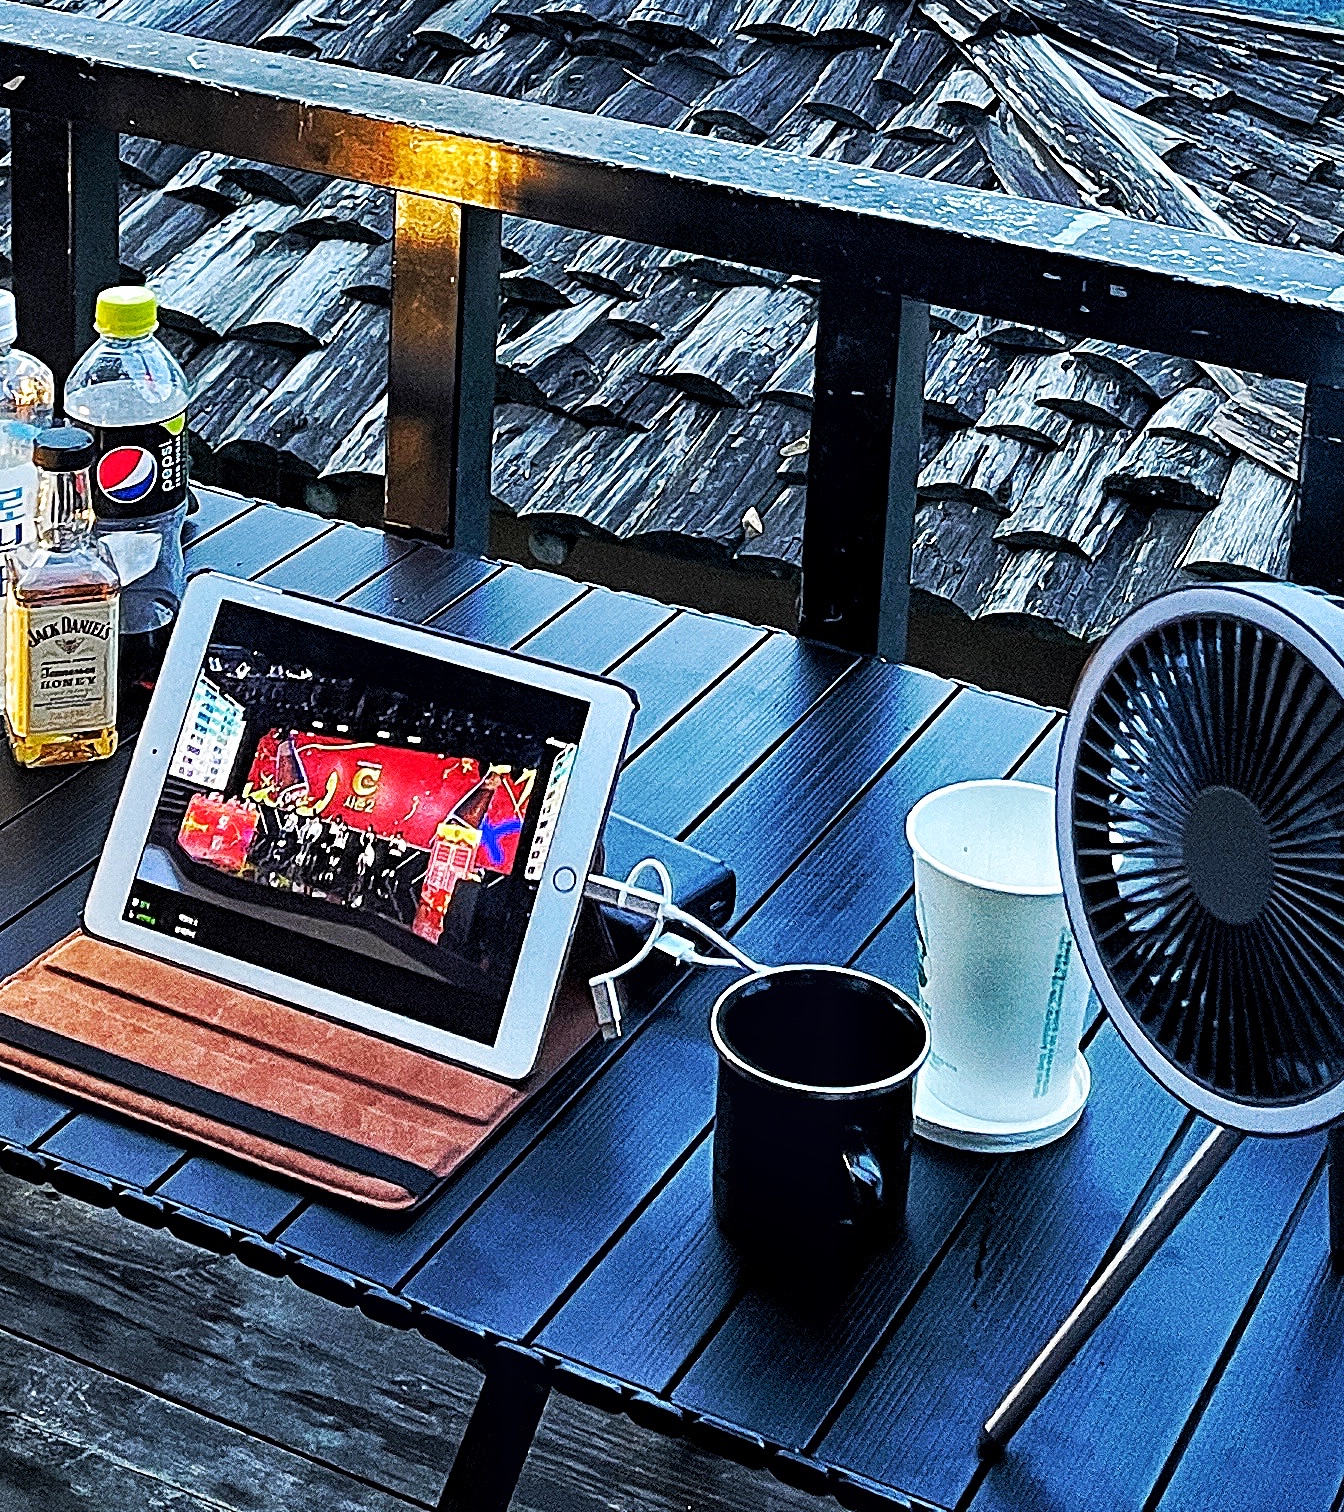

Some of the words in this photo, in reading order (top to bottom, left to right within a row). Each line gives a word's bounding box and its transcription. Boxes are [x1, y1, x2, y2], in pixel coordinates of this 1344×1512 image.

[158, 437, 176, 492] pepsi
[28, 621, 61, 648] JACK
[62, 615, 113, 641] DANIEL'S
[40, 676, 97, 690] HONEY
